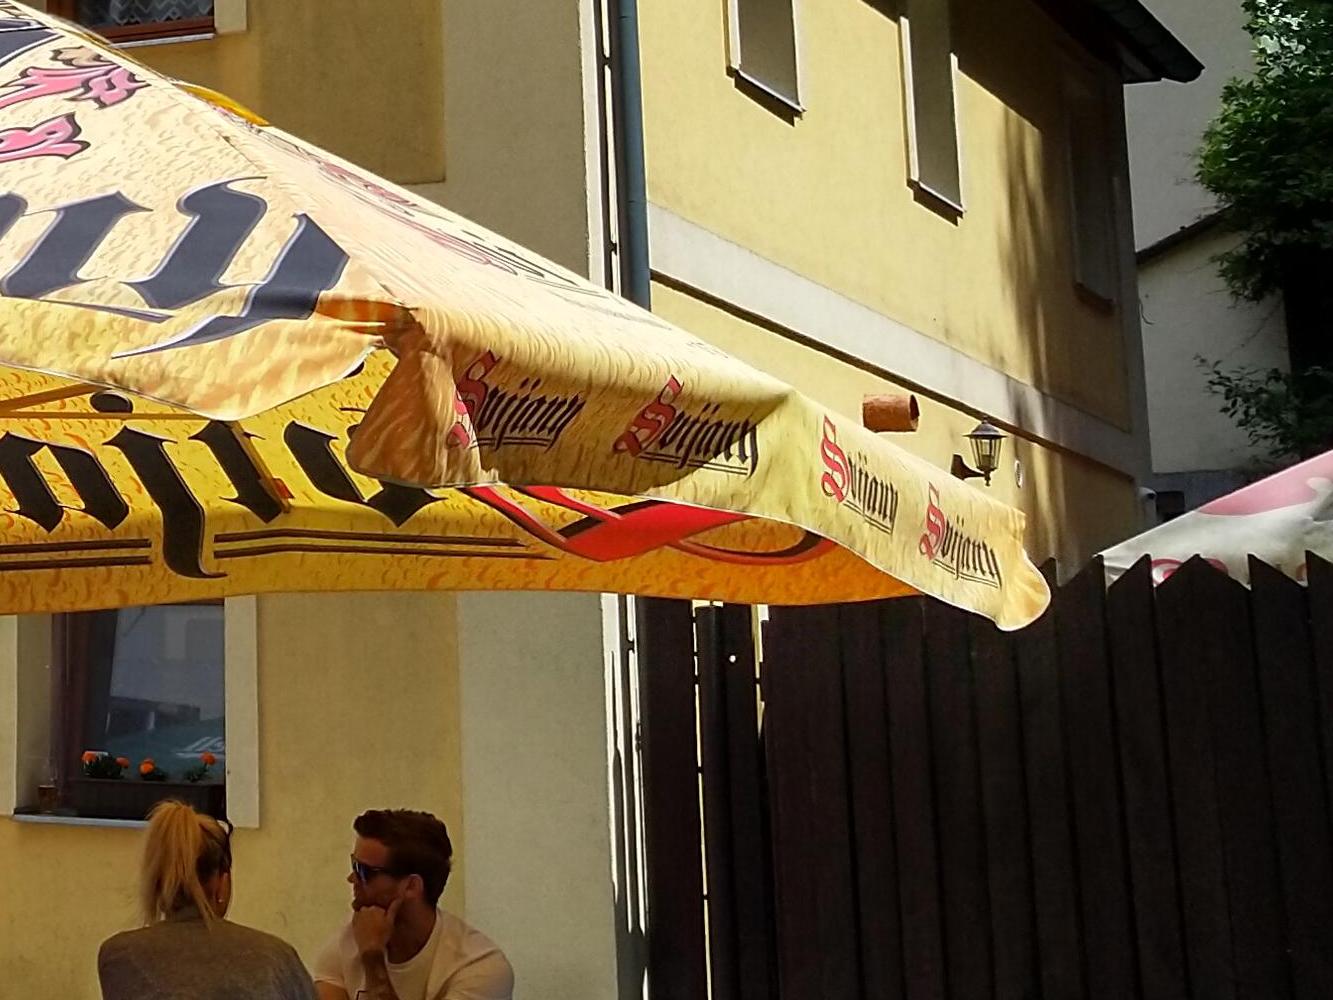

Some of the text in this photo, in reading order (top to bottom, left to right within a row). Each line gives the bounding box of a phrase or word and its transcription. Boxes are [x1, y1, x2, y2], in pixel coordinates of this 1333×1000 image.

[612, 374, 761, 479] Svijany
[820, 414, 899, 535] Svijany
[918, 482, 1003, 590] Svijany
